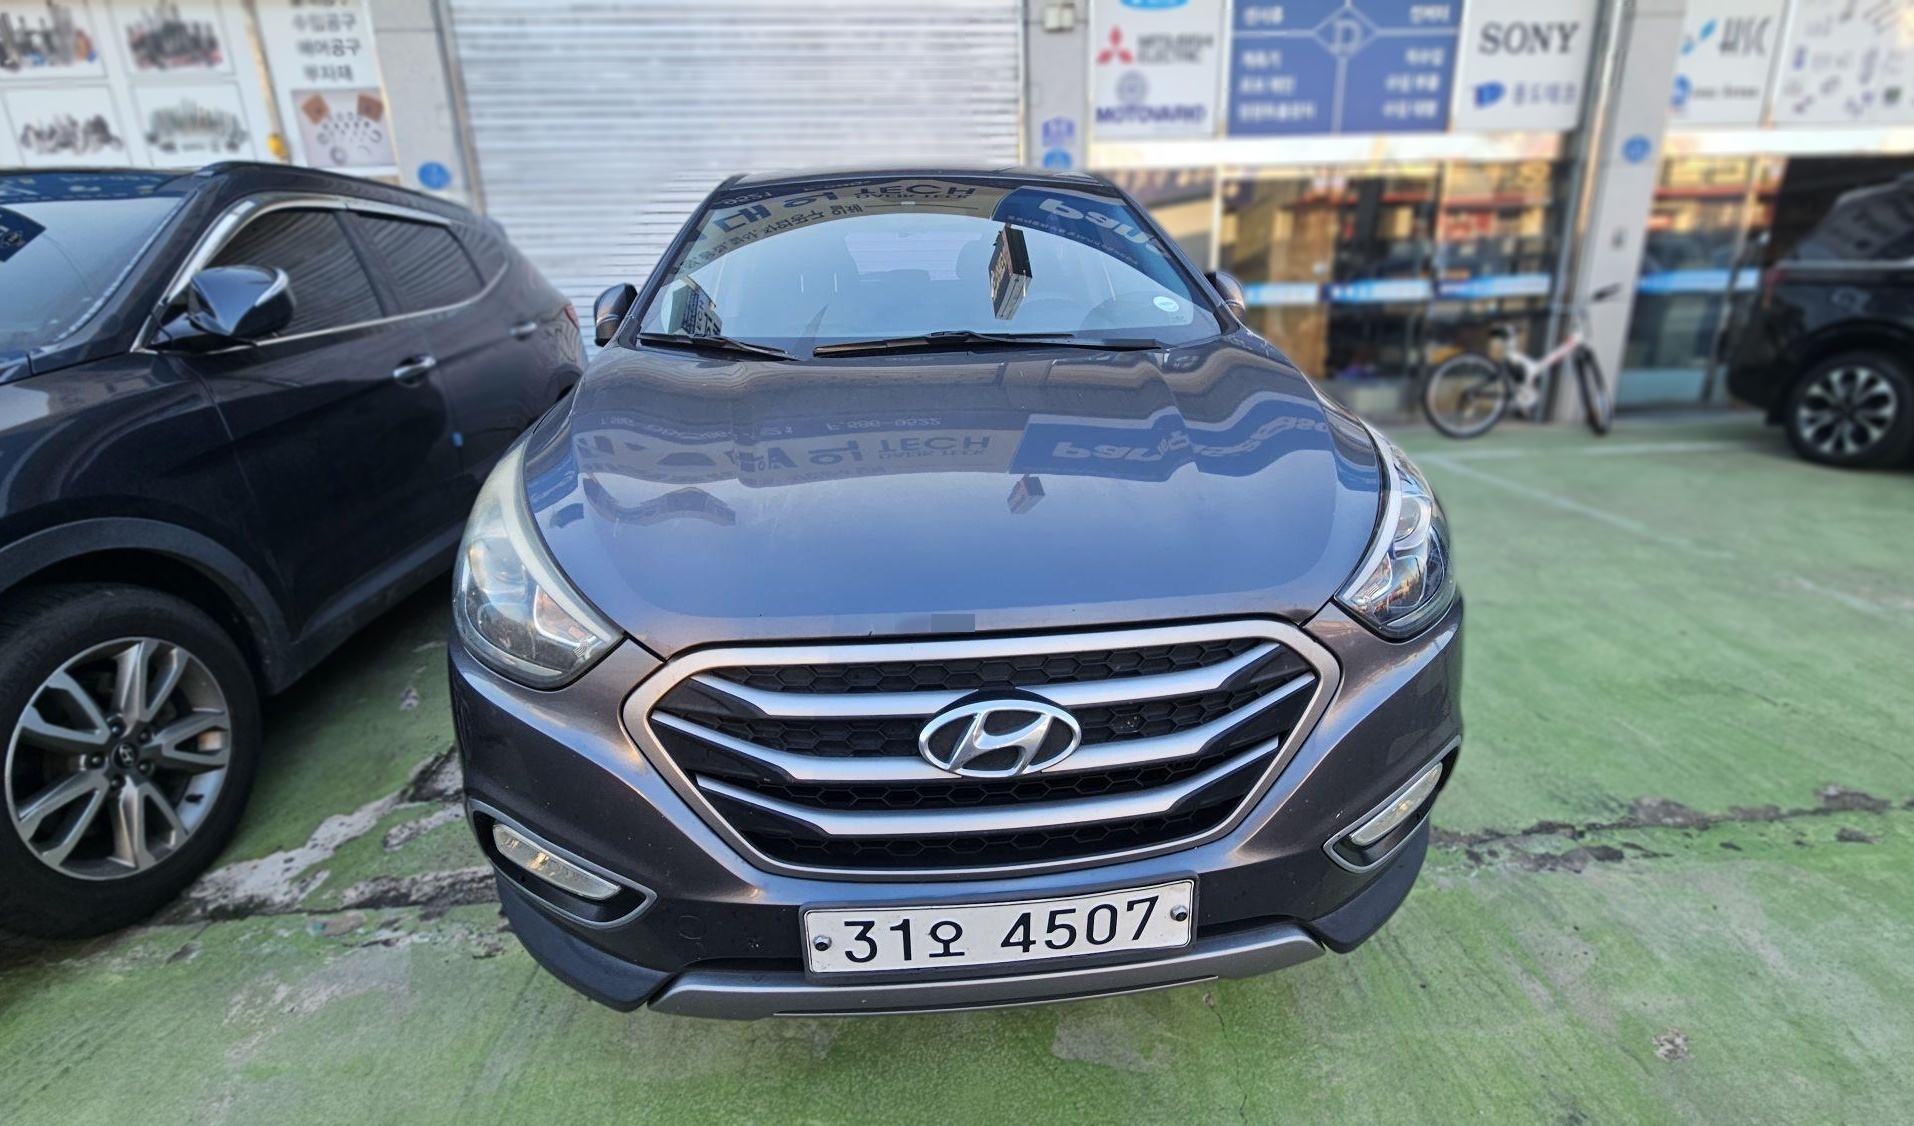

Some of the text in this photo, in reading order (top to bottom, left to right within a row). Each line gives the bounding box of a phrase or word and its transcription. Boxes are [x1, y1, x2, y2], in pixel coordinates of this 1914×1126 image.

[1478, 20, 1580, 55] SONY
[844, 895, 1160, 963] 31오 4507
